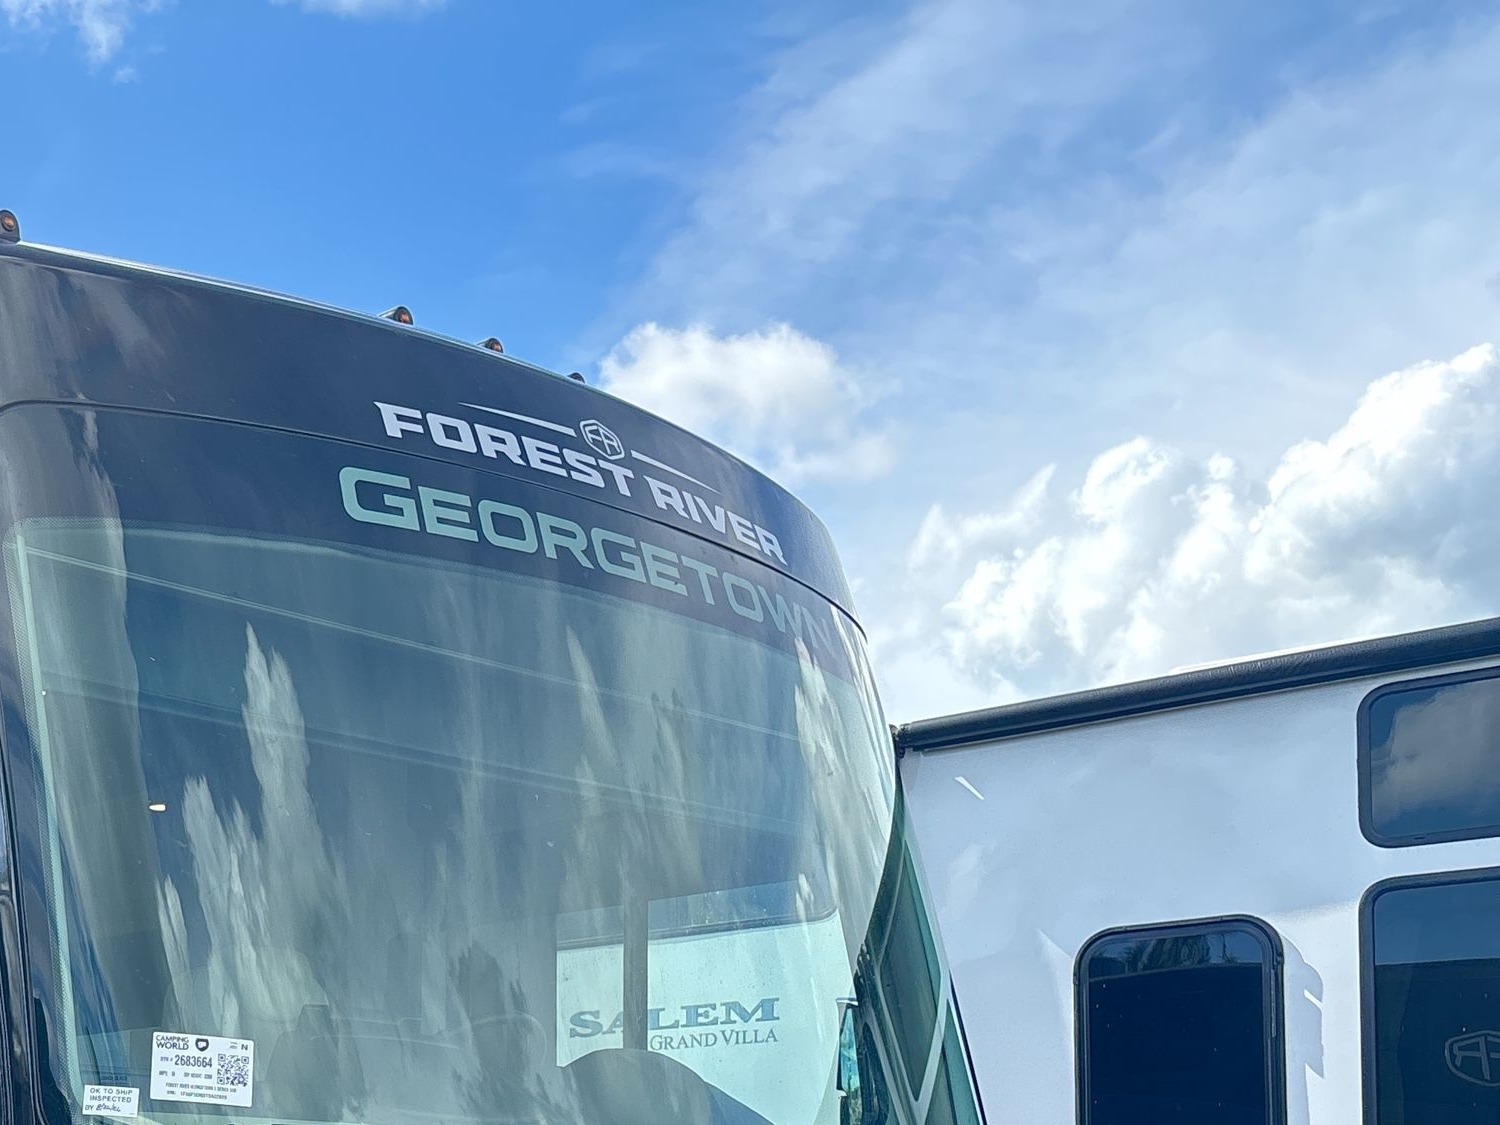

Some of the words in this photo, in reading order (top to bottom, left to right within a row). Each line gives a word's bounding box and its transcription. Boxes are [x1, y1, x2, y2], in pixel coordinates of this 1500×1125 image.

[373, 401, 634, 497] FOREST
[643, 475, 789, 566] RIVER
[338, 465, 837, 659] GEORGETOWN
[155, 1034, 189, 1043] CAMPING
[155, 1041, 189, 1050] WORLD
[649, 1031, 718, 1051] GRAND
[719, 1028, 778, 1046] VILLA
[174, 1054, 213, 1069] 2683664
[89, 1095, 132, 1104] INSPECTED
